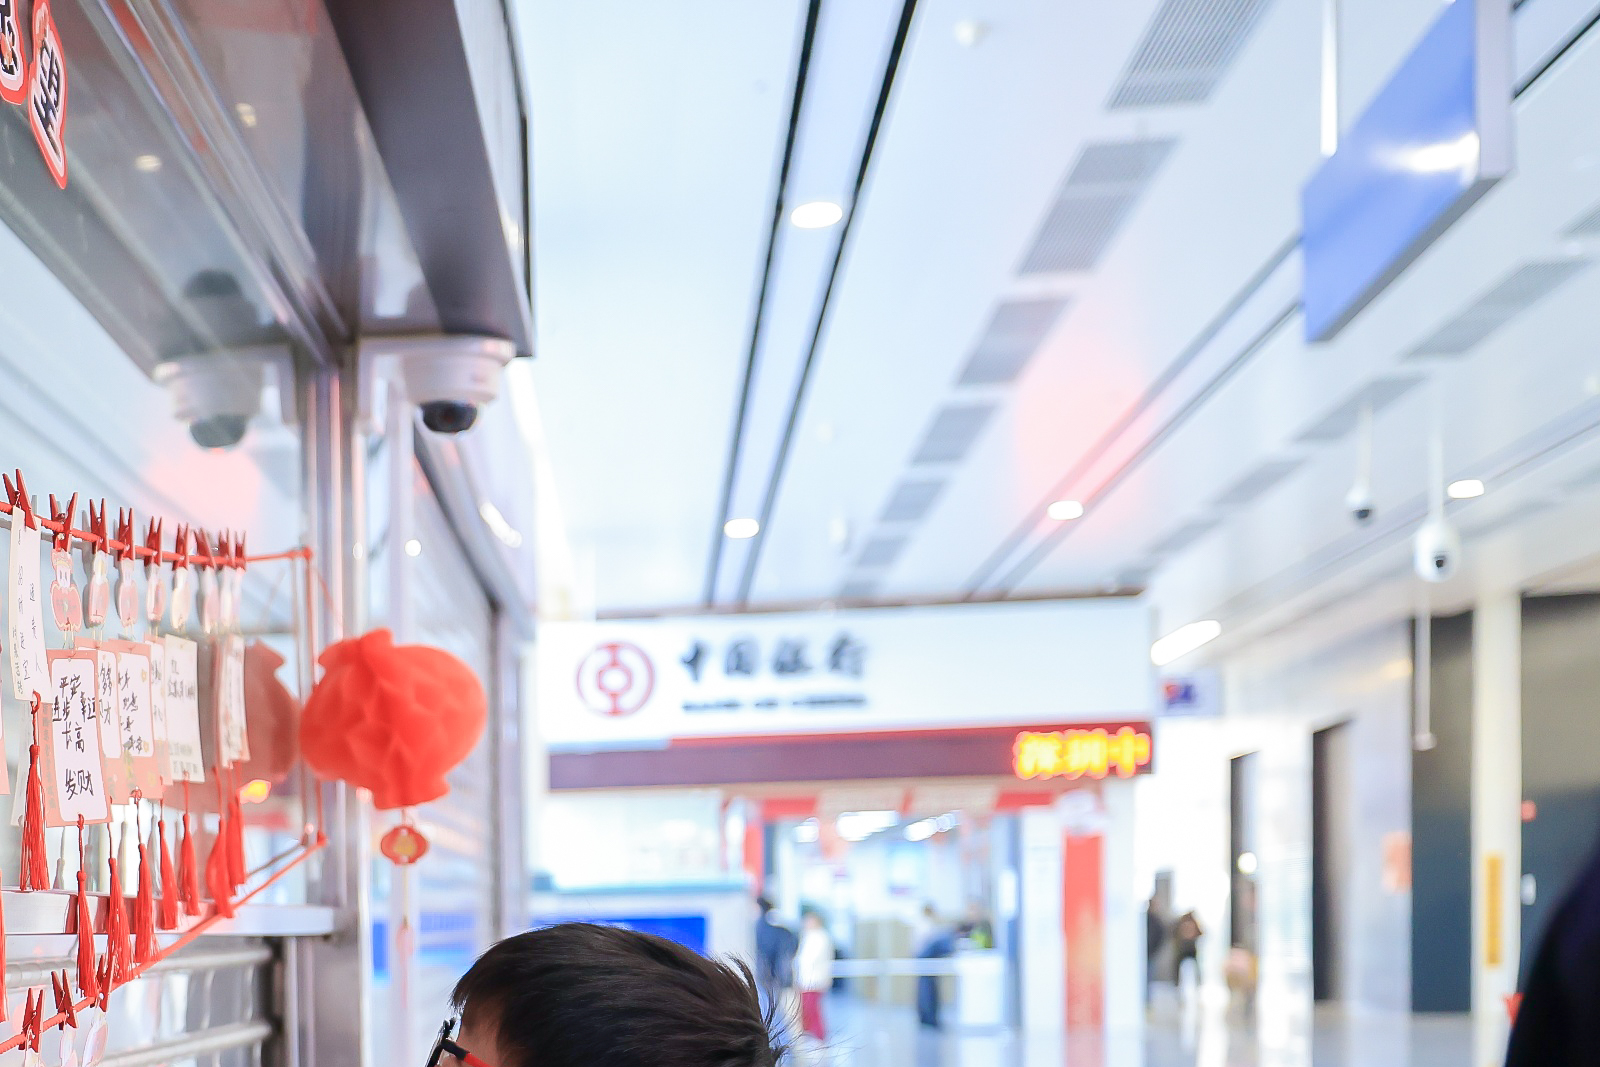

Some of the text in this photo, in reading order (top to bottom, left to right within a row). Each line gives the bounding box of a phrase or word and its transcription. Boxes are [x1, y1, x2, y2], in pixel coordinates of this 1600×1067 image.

[59, 674, 82, 700] 平安
[52, 691, 97, 724] 进步 幸运
[61, 720, 86, 753] 长高
[65, 768, 95, 801] 发财
